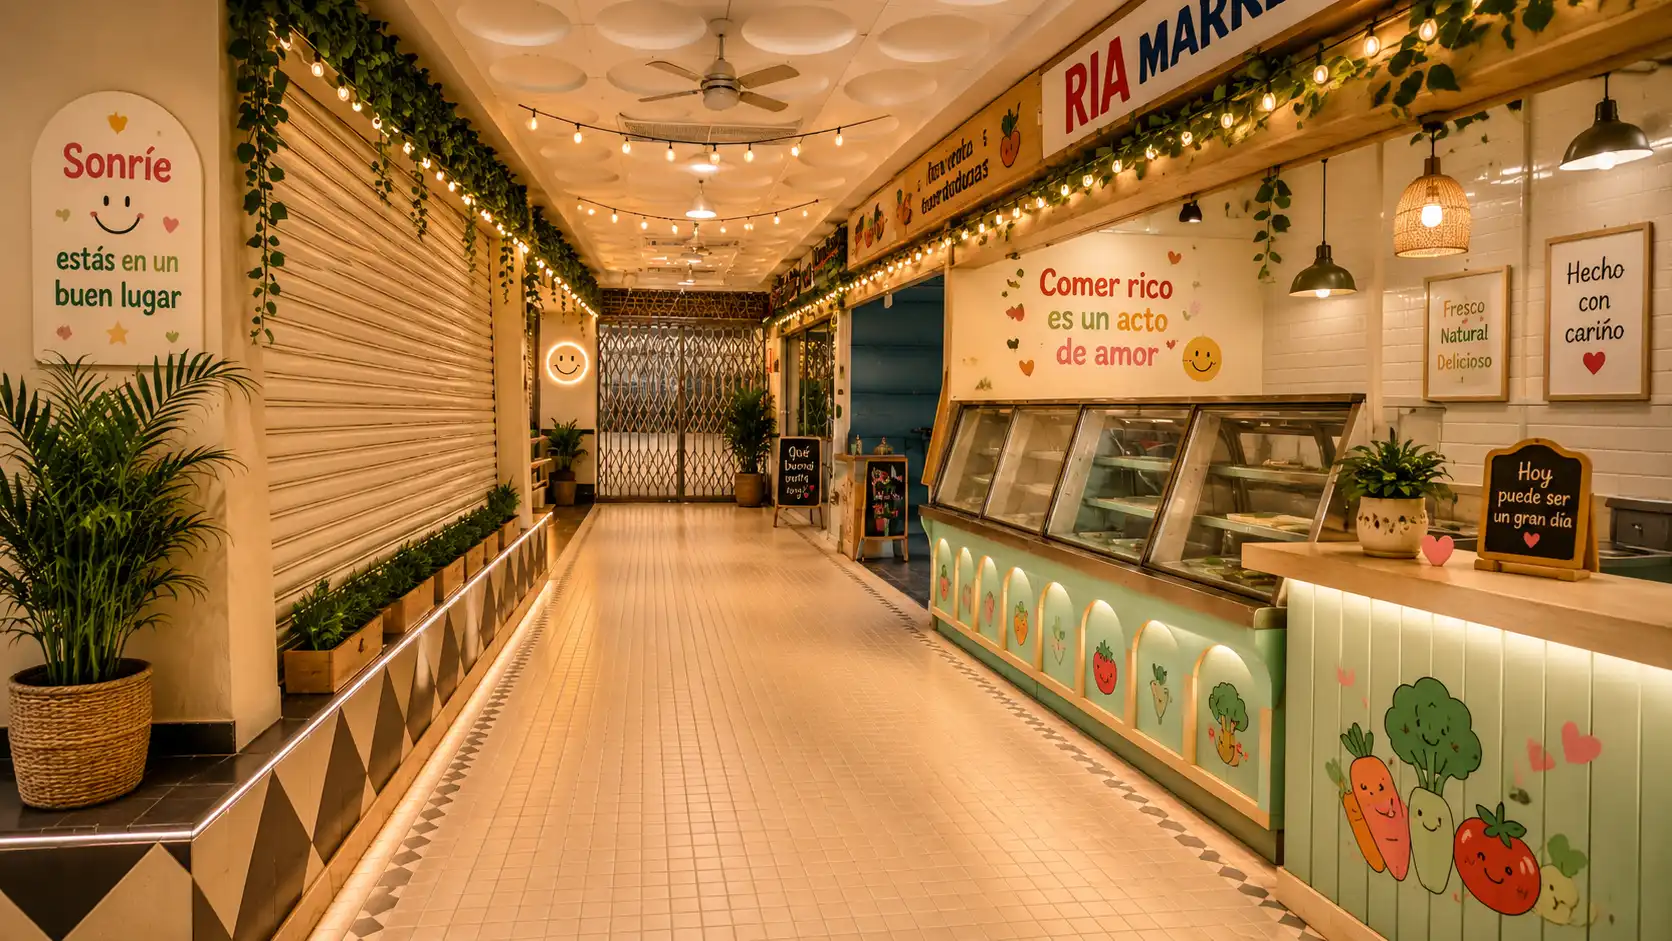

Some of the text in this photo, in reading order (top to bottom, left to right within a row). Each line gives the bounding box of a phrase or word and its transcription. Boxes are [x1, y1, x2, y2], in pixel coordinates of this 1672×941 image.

[1065, 0, 1286, 134] RIA MARK
[63, 142, 171, 183] Sonríe
[56, 246, 178, 272] estás en un
[1566, 256, 1625, 284] Hecho
[1040, 268, 1173, 300] Comer rico
[55, 279, 182, 316] buen lugar
[1443, 299, 1485, 318] Fresco
[1579, 294, 1611, 312] con
[1047, 308, 1168, 333] es un acto
[1440, 324, 1488, 344] Natural
[1056, 337, 1160, 367] de amor
[1437, 352, 1492, 371] Delicioso
[1518, 461, 1553, 488] Hoy
[1497, 487, 1571, 507] puede ser
[1493, 511, 1572, 529] un gran día
